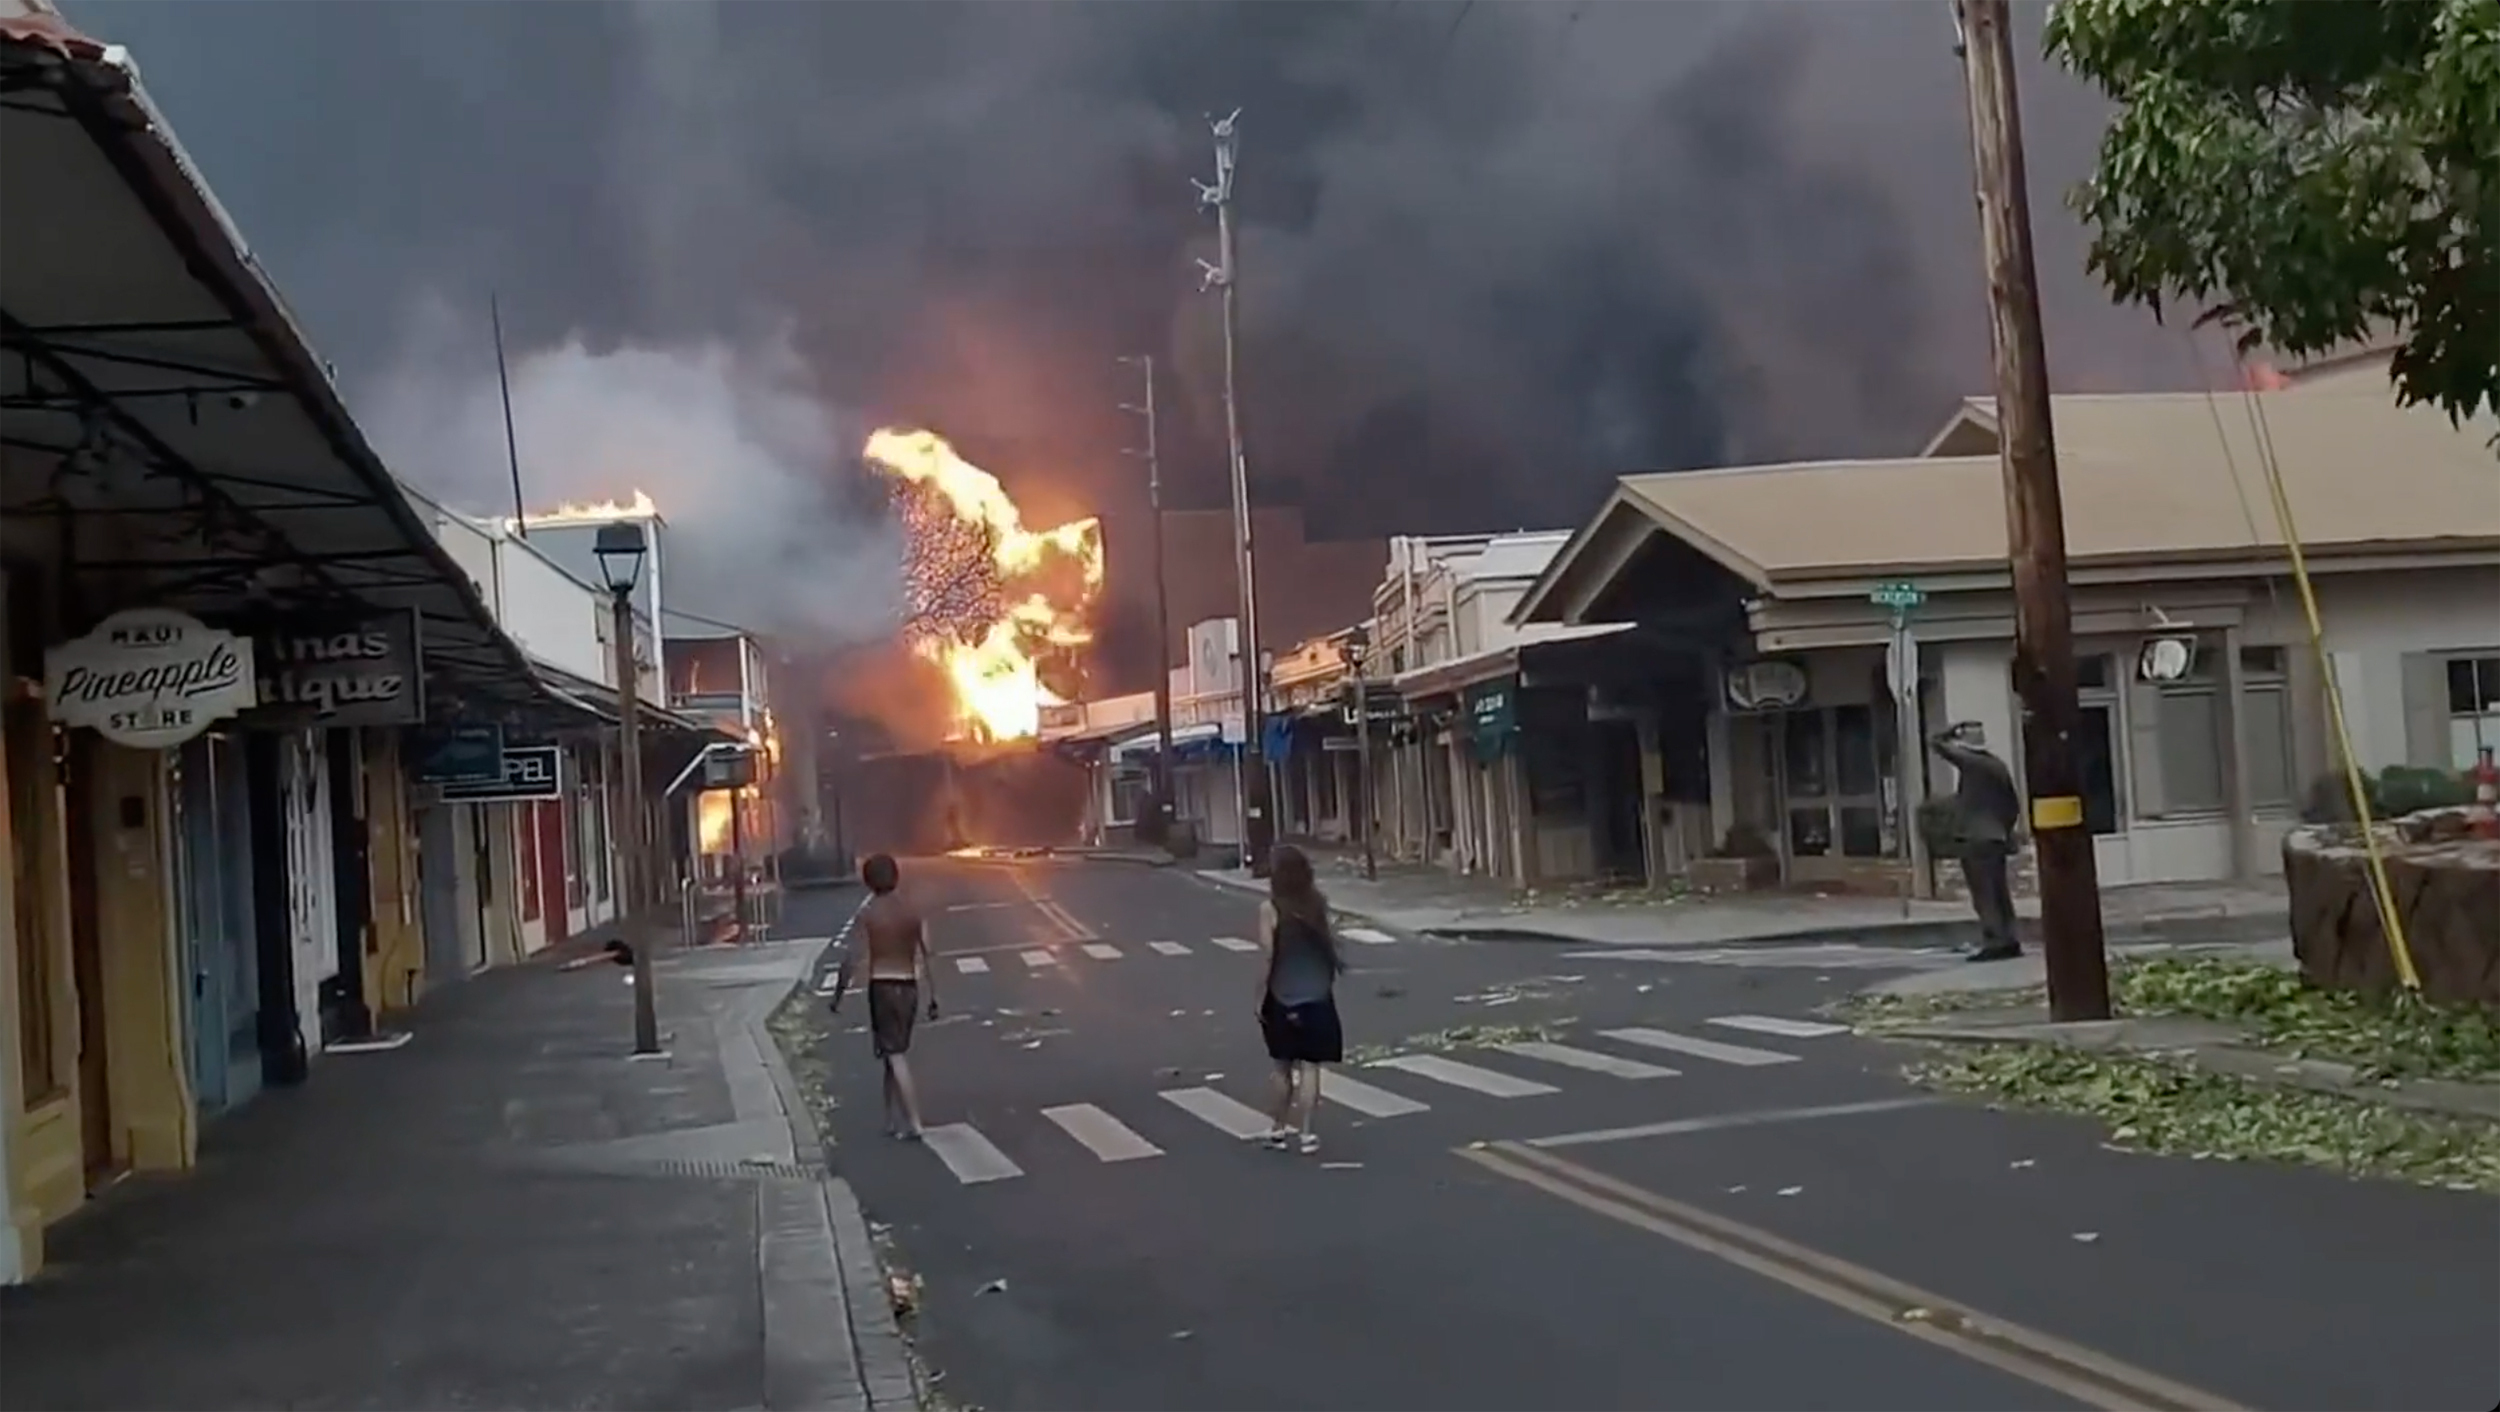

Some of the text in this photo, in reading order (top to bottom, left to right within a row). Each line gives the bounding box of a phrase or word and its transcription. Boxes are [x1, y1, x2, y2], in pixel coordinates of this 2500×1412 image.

[111, 626, 183, 644] MAUI
[57, 643, 241, 705] Pineapple
[258, 668, 402, 714] tique
[504, 757, 553, 782] PEL
